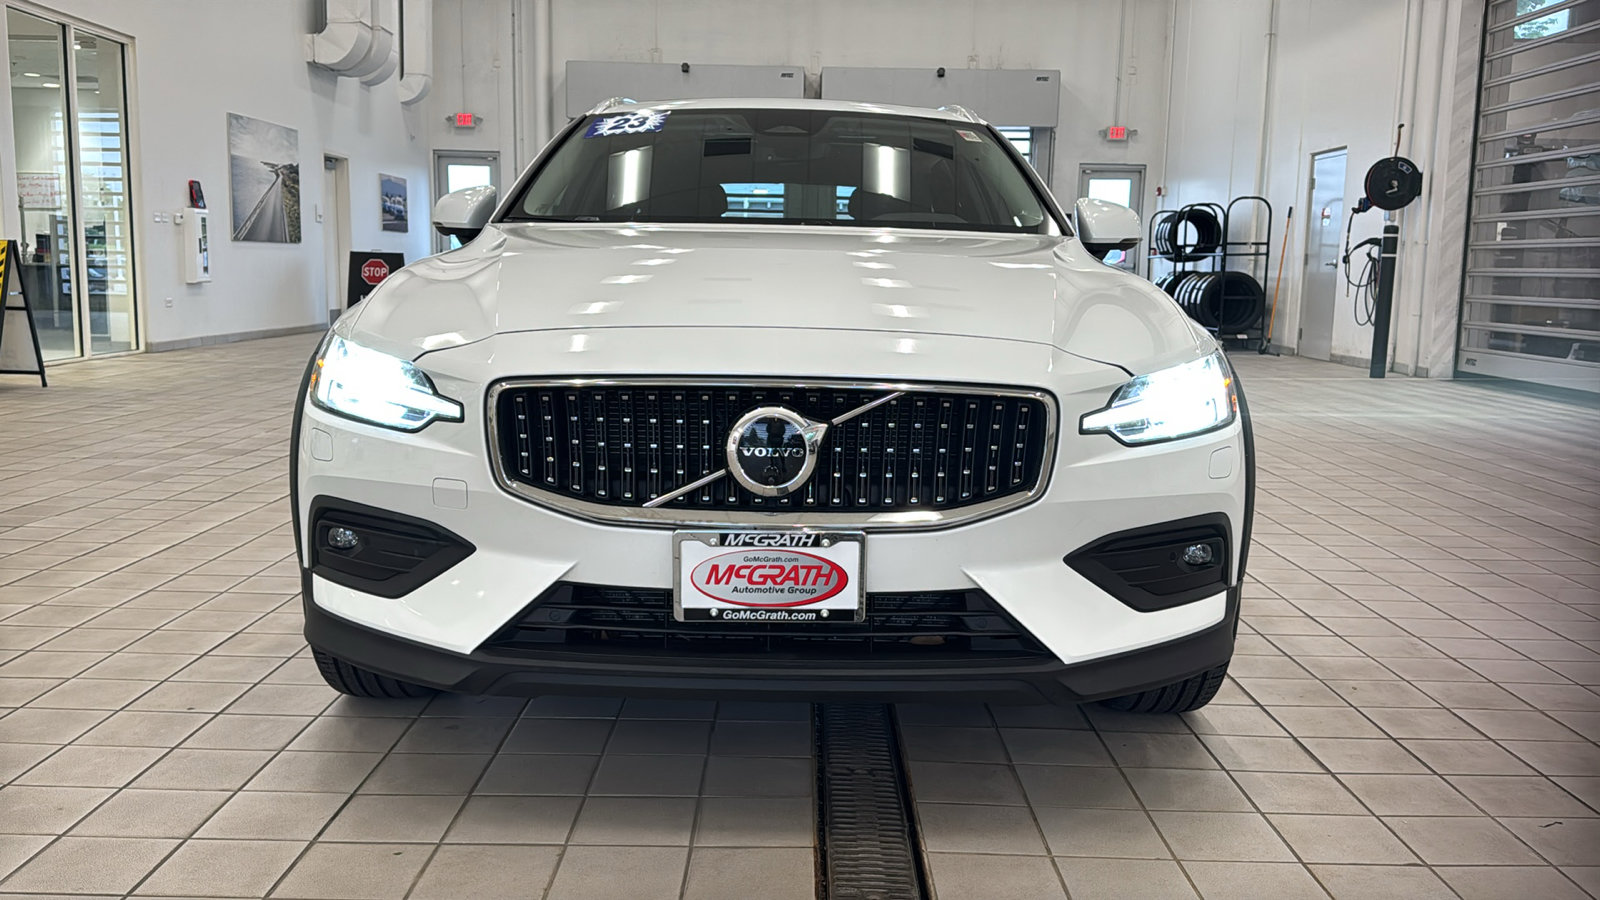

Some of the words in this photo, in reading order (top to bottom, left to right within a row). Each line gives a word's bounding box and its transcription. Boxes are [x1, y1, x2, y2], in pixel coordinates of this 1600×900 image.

[608, 116, 649, 131] 23
[364, 266, 387, 277] STOP
[739, 446, 804, 457] VOLVO
[743, 555, 799, 564] GoMcGrath.com
[731, 586, 785, 594] Automotive
[787, 586, 817, 596] Group
[722, 610, 816, 621] GoMcGrath.com
